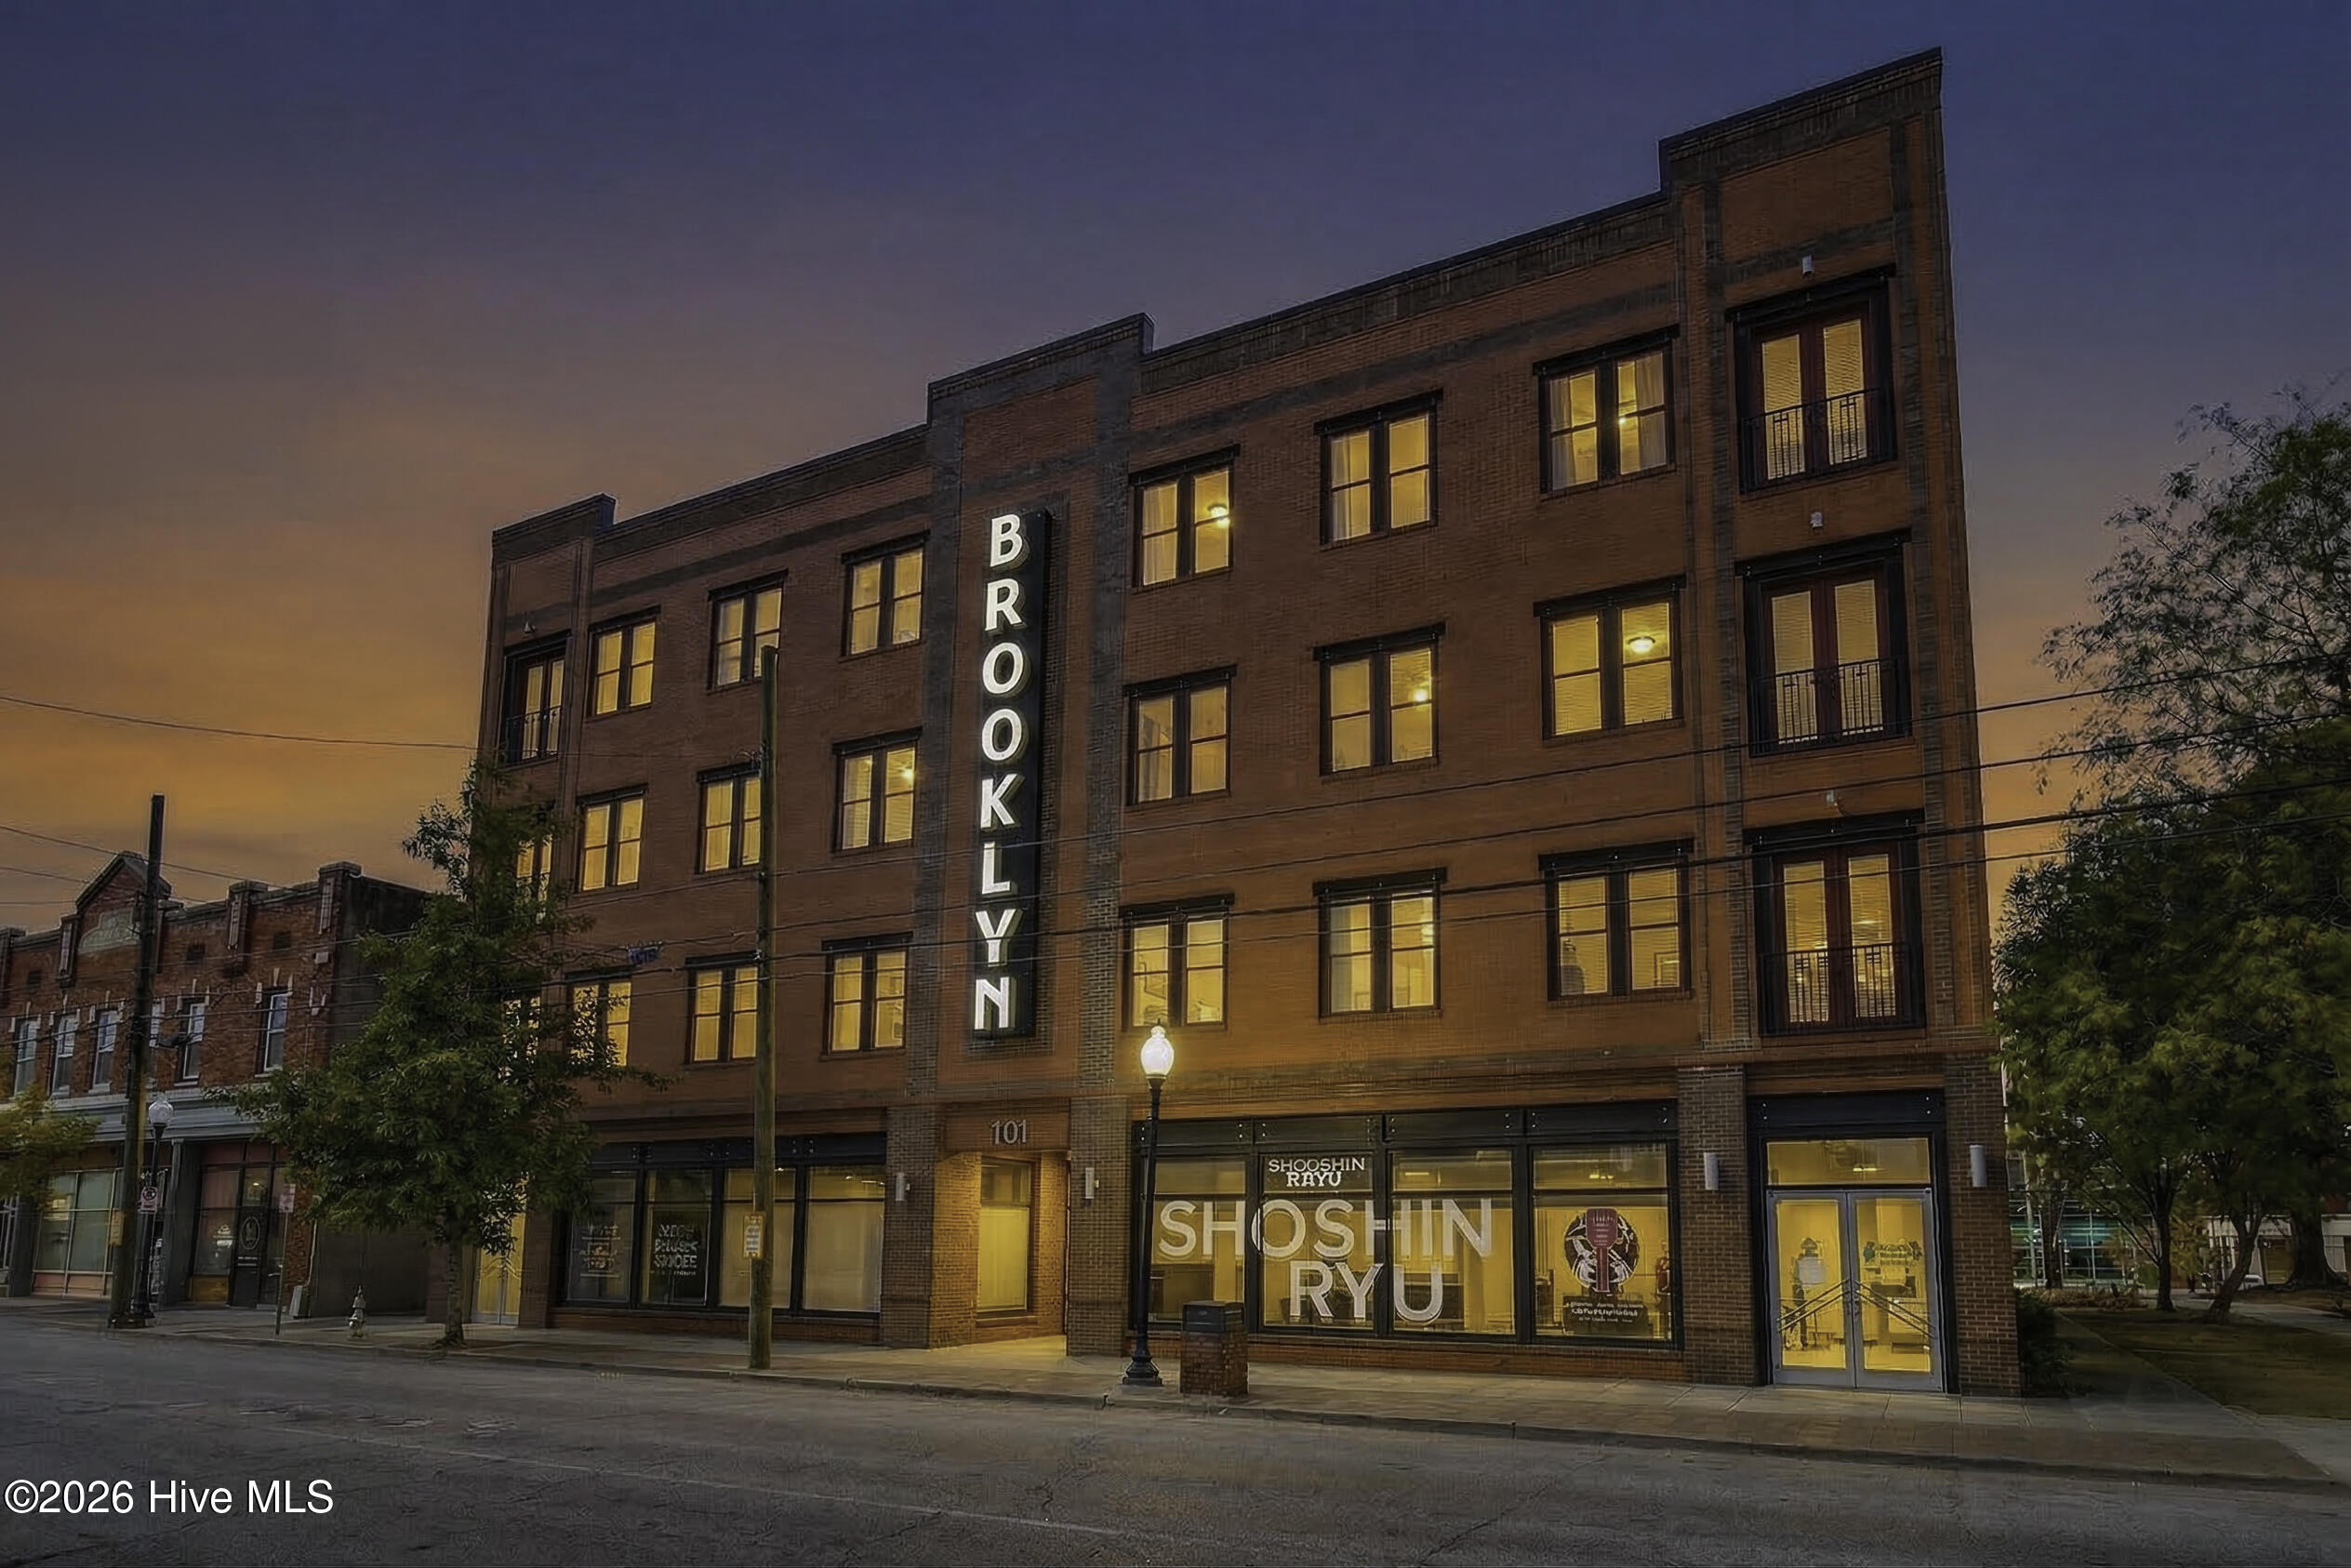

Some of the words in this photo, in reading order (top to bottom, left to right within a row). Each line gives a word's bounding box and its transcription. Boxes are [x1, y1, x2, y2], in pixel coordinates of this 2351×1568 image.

[974, 512, 1027, 1030] BROOKLYN
[990, 1119, 1027, 1145] 101
[1268, 1157, 1365, 1173] SHOOSHIN
[1286, 1171, 1342, 1188] RAYU
[1159, 1197, 1493, 1259] SHOSHIN
[1288, 1260, 1444, 1324] RYU
